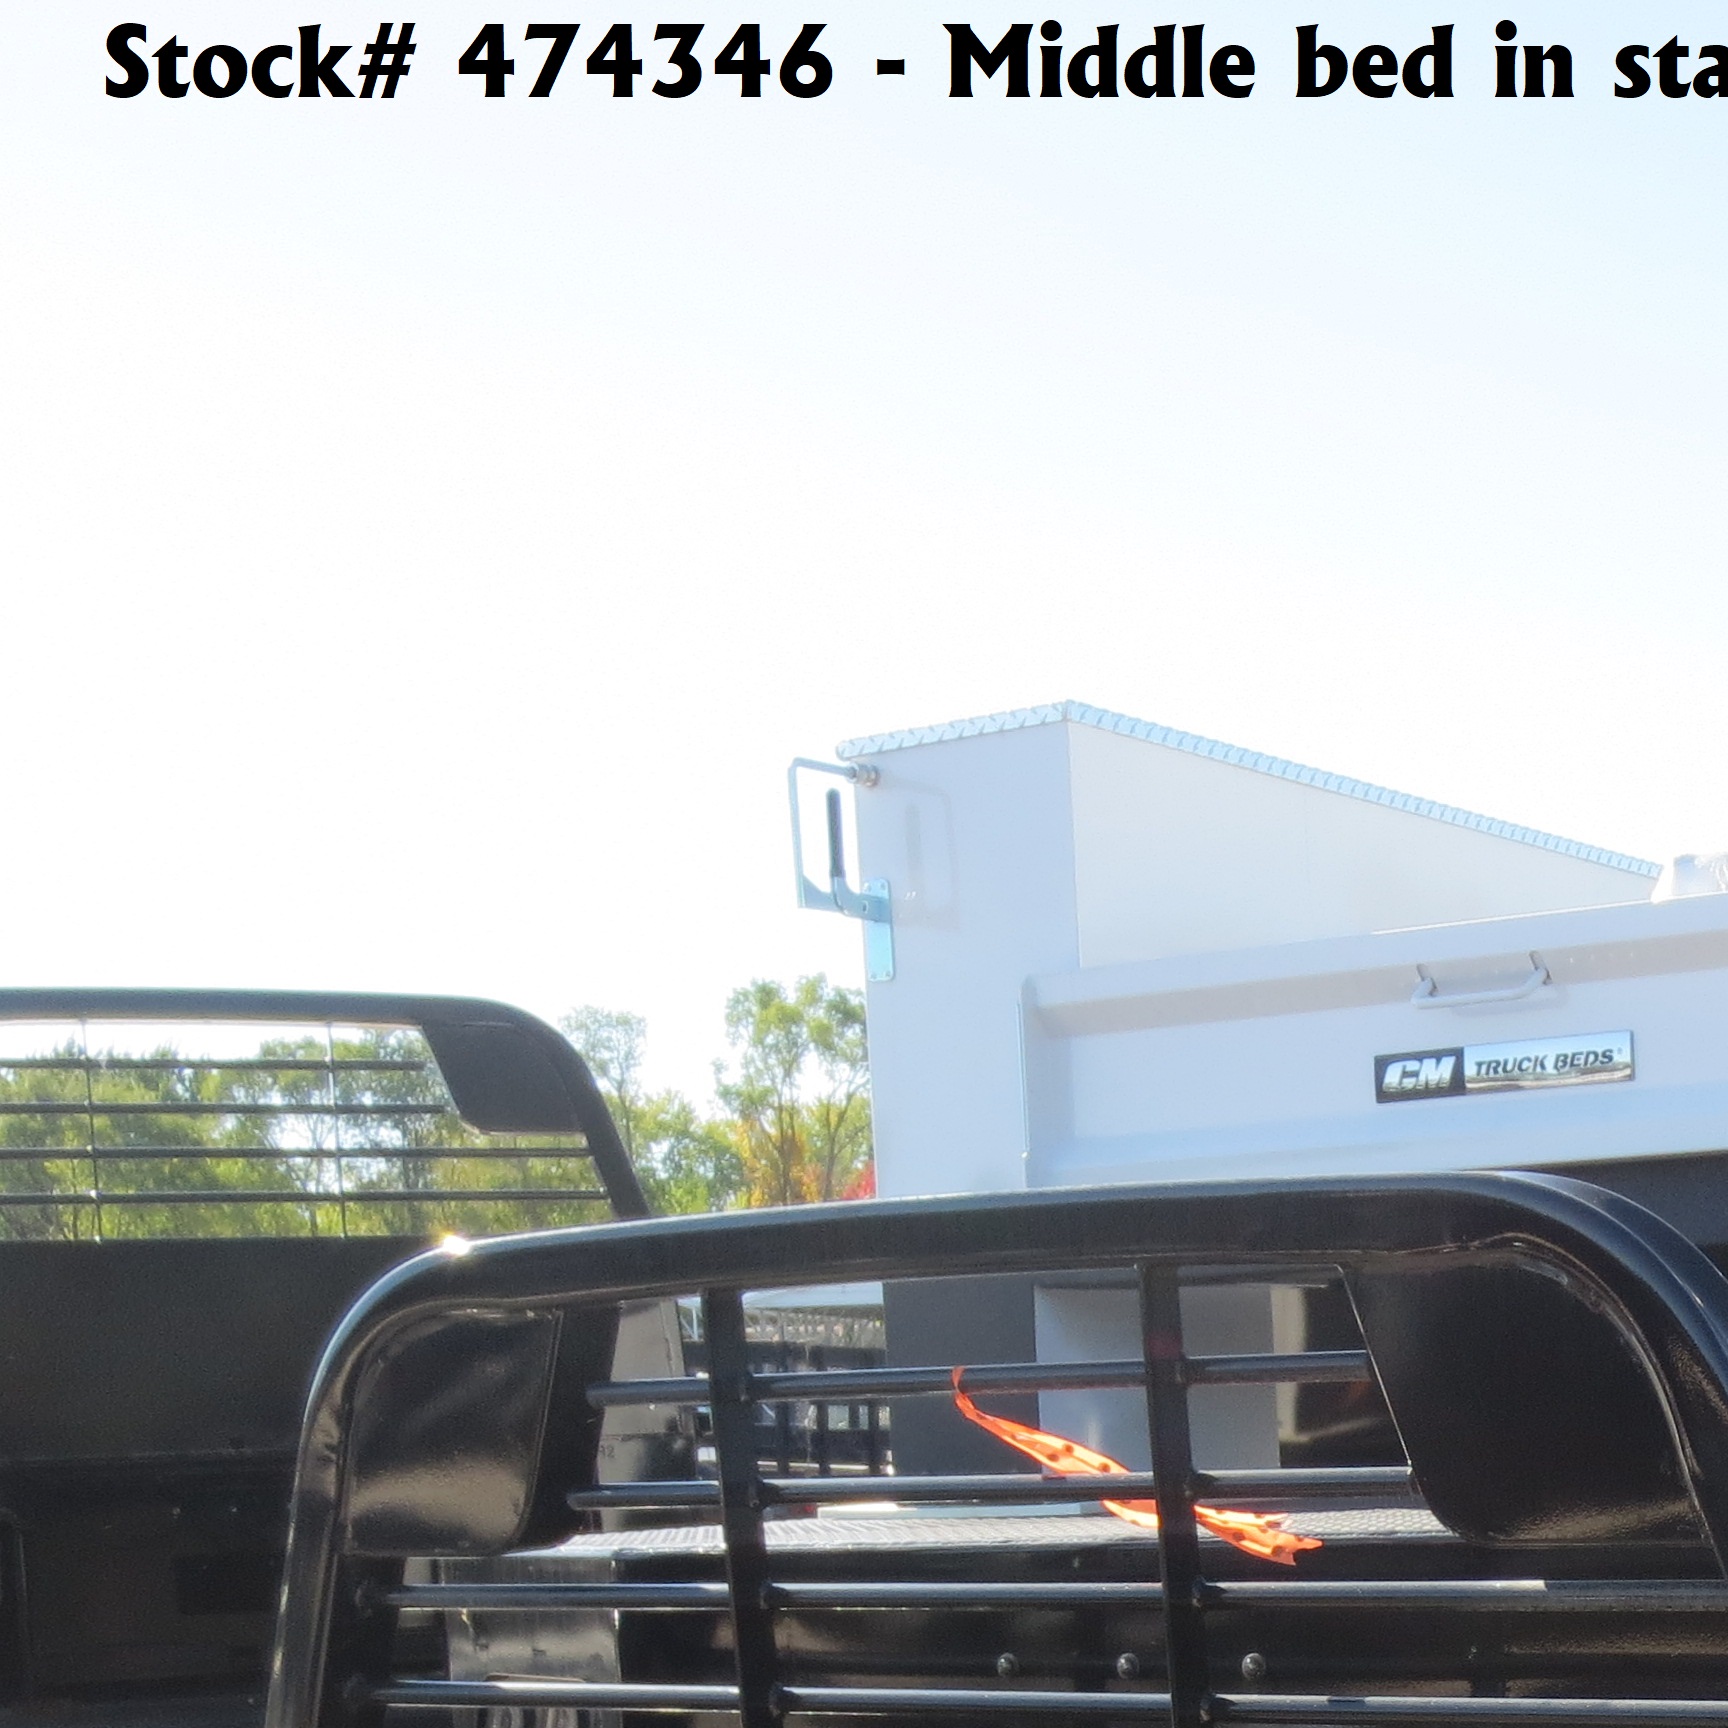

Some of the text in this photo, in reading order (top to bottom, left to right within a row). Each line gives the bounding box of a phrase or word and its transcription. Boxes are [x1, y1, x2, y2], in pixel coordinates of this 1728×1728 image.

[1382, 1048, 1614, 1092] CM TRUCK BEDS
